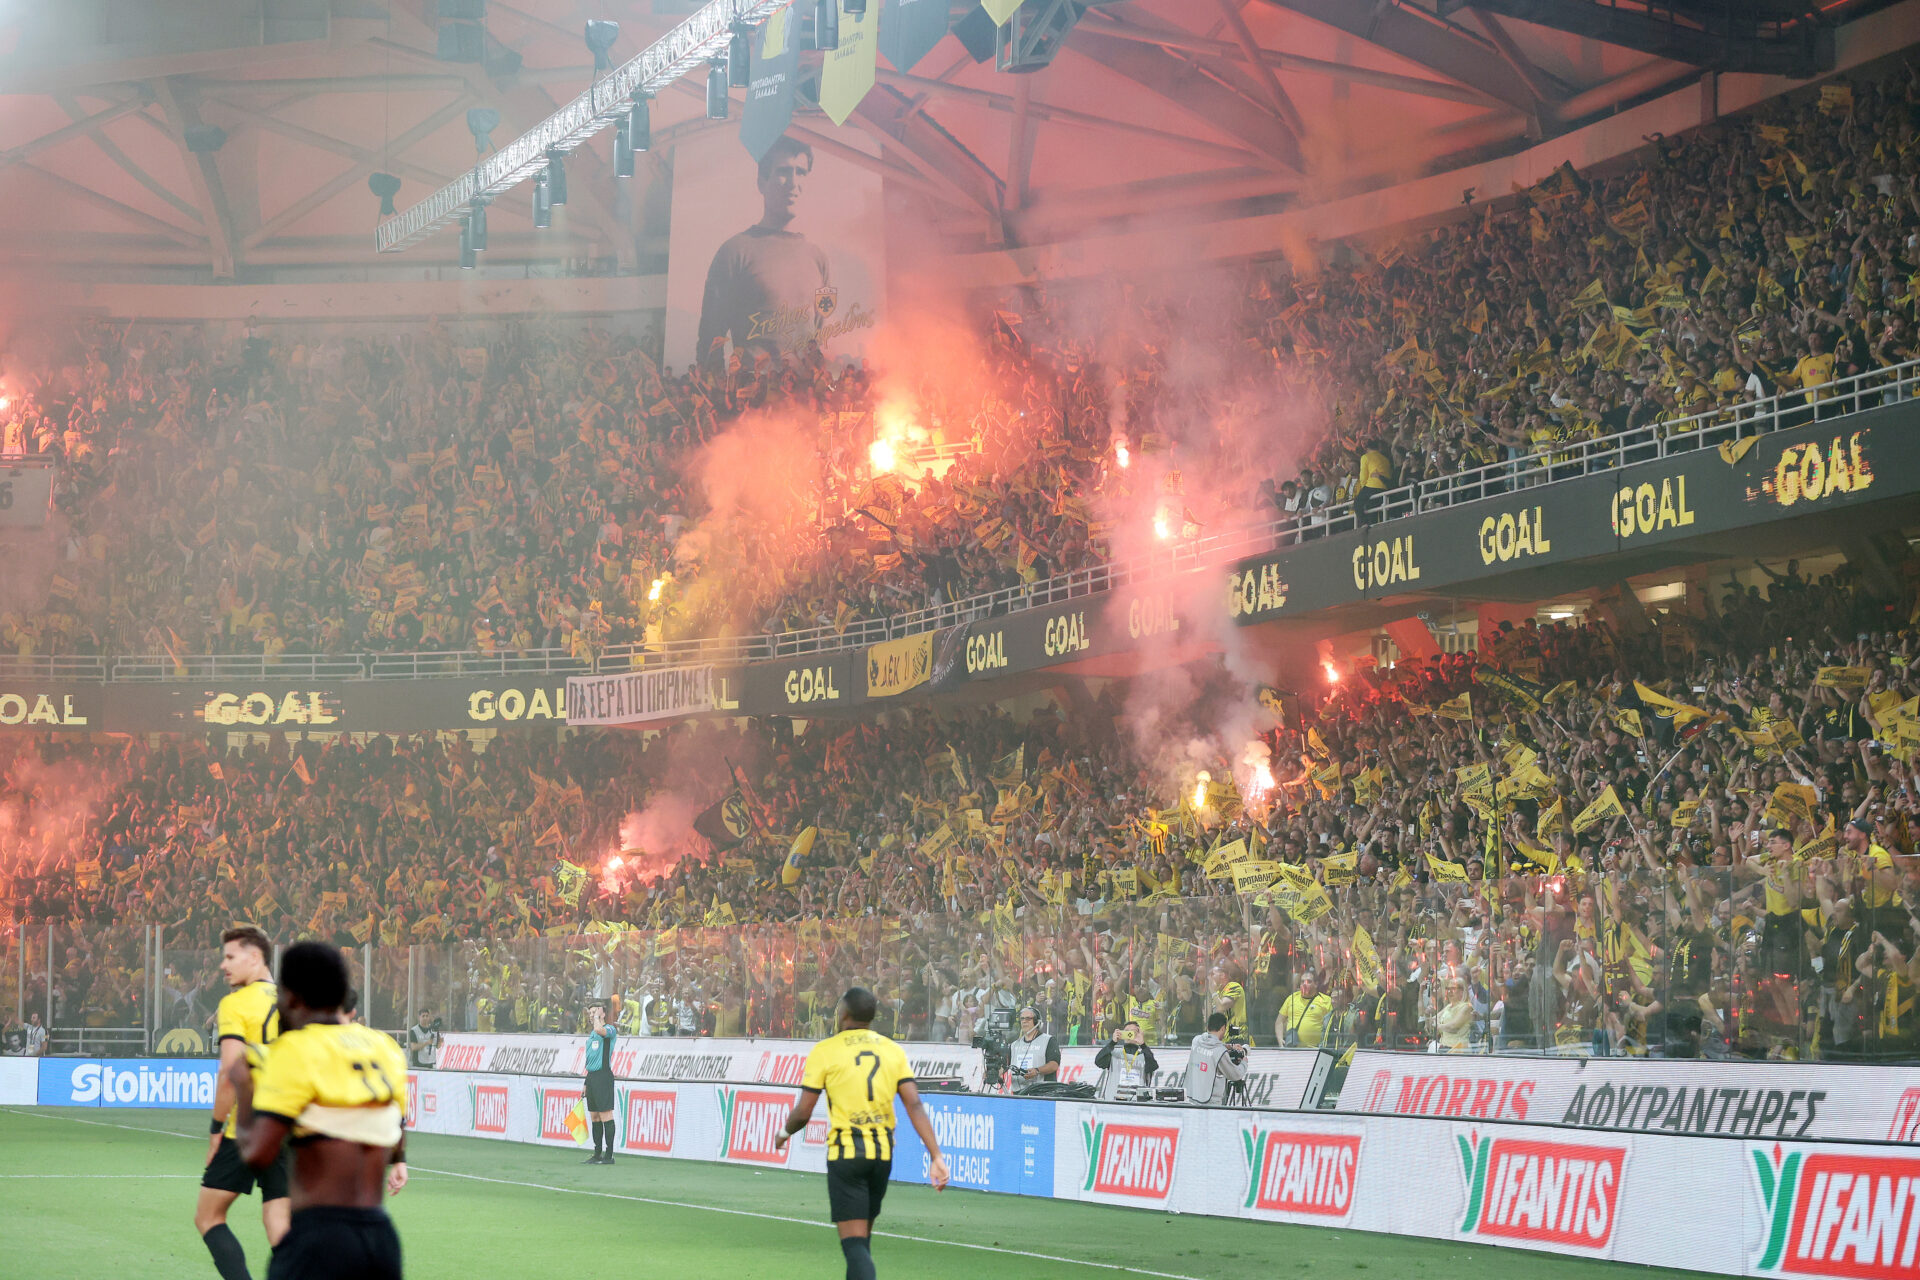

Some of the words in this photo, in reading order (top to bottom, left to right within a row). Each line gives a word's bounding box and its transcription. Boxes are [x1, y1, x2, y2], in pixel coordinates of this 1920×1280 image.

[1775, 431, 1874, 506] GOAL
[1611, 475, 1695, 538] GOAL
[1479, 506, 1551, 566] GOAL
[1353, 535, 1420, 590] GOAL
[1227, 563, 1286, 618] GOAL
[1044, 611, 1090, 657] GOAL
[1128, 593, 1179, 639] GOAL
[966, 630, 1008, 674] GOAL
[204, 691, 338, 725] GOAL
[467, 687, 566, 722] GOAL
[568, 679, 625, 720] ΠΑΤΕΡΑ
[625, 675, 644, 715] ΤΟ
[784, 666, 840, 704] GOAL
[0, 693, 87, 725] OAL
[1238, 872, 1276, 889] ΠΡΩΤΑΘΛΗΤ
[440, 1044, 485, 1070] MORRIS
[611, 1050, 637, 1077] RIS
[769, 1054, 806, 1085] MOR
[855, 1051, 880, 1102] 7
[71, 1063, 215, 1103] Stoixima
[1394, 1074, 1536, 1121] MORRIS
[478, 1091, 506, 1129] IFANTIS
[544, 1093, 580, 1137] IFANT
[630, 1099, 673, 1147] IFANTIS
[1562, 1081, 1827, 1136] ΑΦΥΓΡΑΝΤΗΡΕΣ
[953, 1155, 990, 1185] LEAGUE
[1101, 1134, 1172, 1193] IFANTIS
[1264, 1143, 1353, 1210] IFANTIS
[1487, 1153, 1613, 1239] IFANTIS
[1797, 1171, 1920, 1270] IFANT
